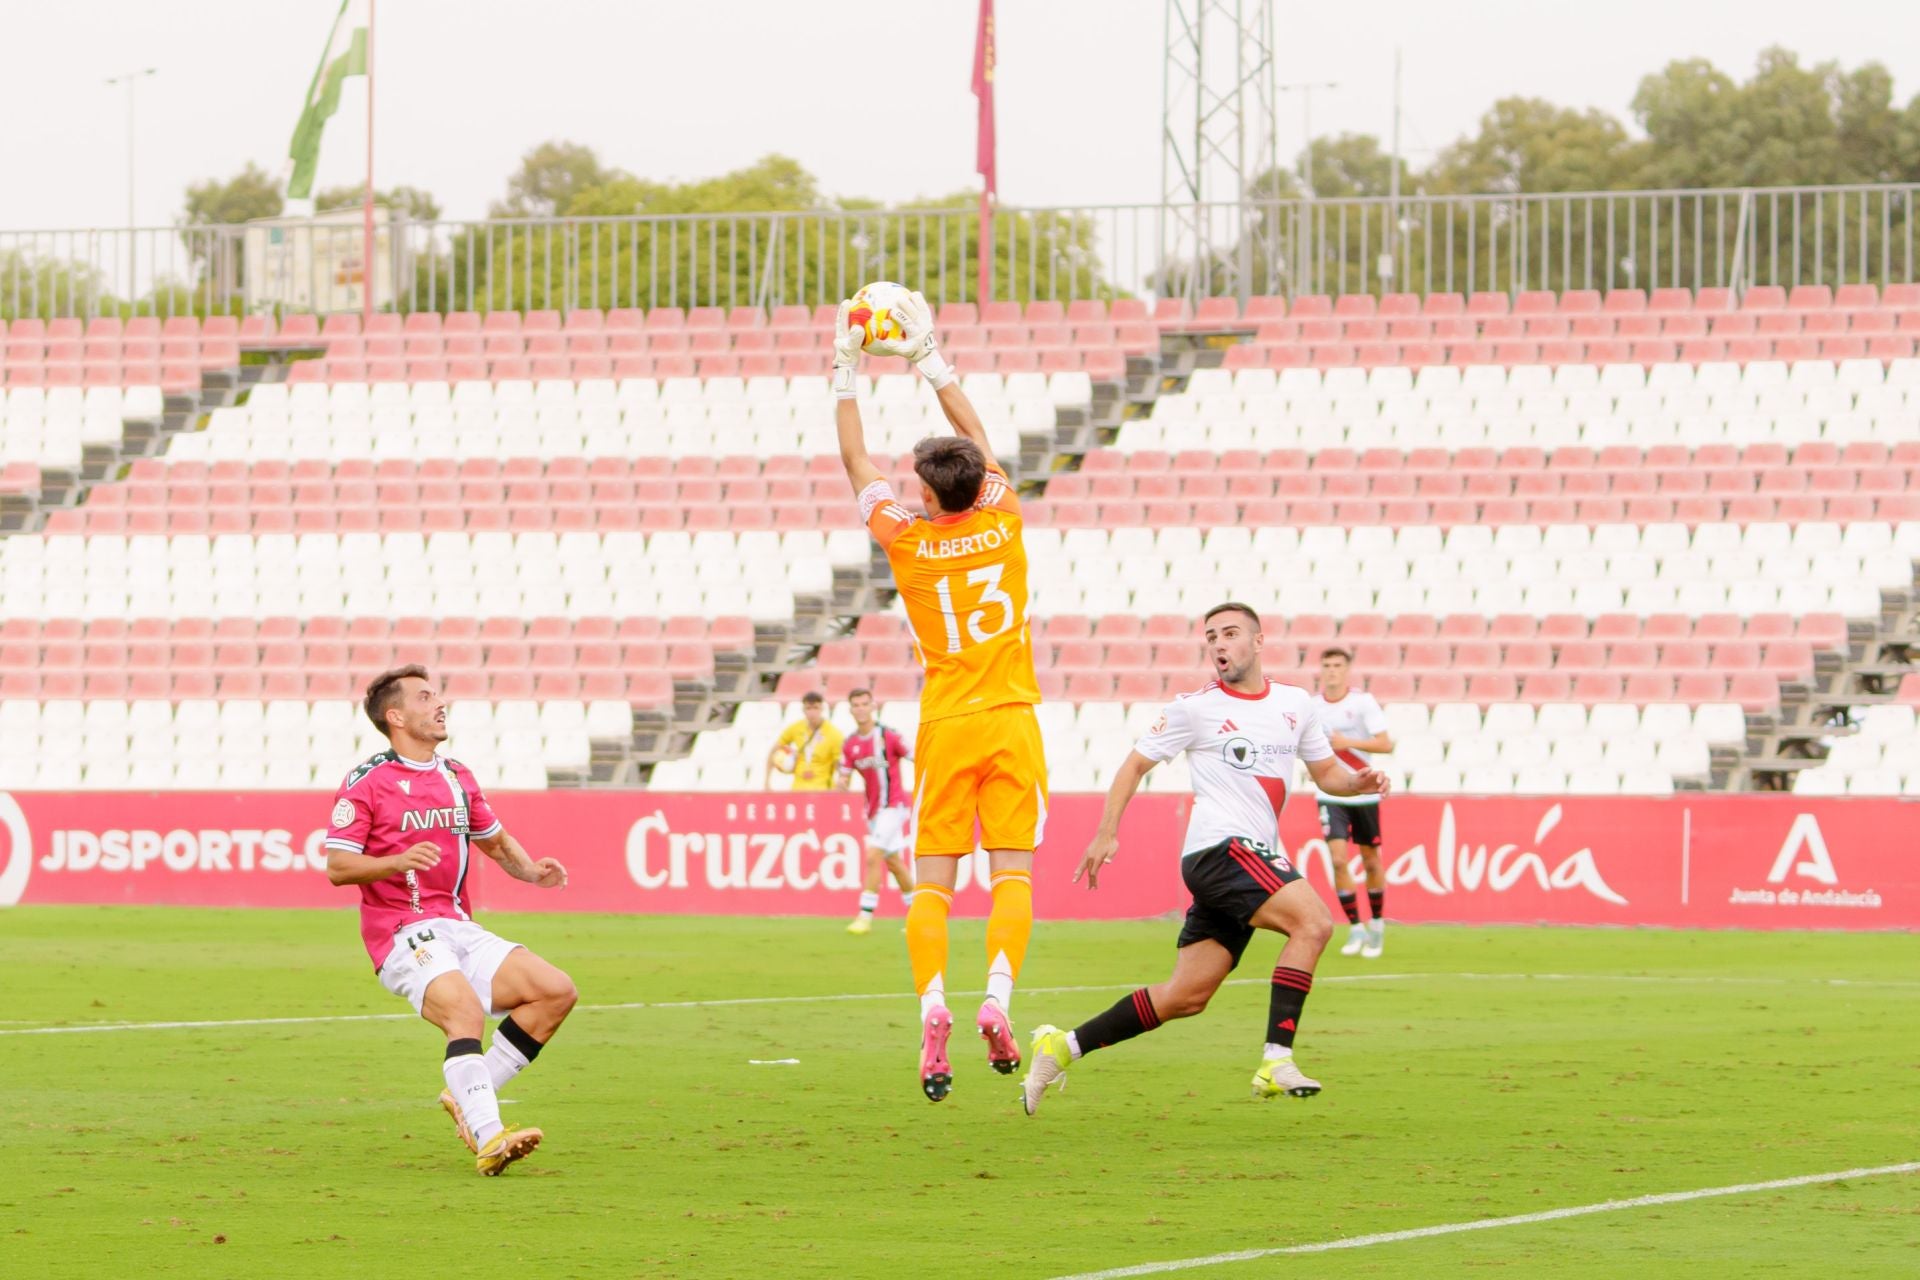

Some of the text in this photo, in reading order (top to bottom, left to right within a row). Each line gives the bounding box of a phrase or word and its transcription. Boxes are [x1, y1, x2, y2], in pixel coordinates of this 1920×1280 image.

[915, 530, 1000, 559] ALBERTO
[934, 562, 1014, 654] 13
[625, 809, 990, 891] Cruzca
[1777, 888, 1799, 905] de
